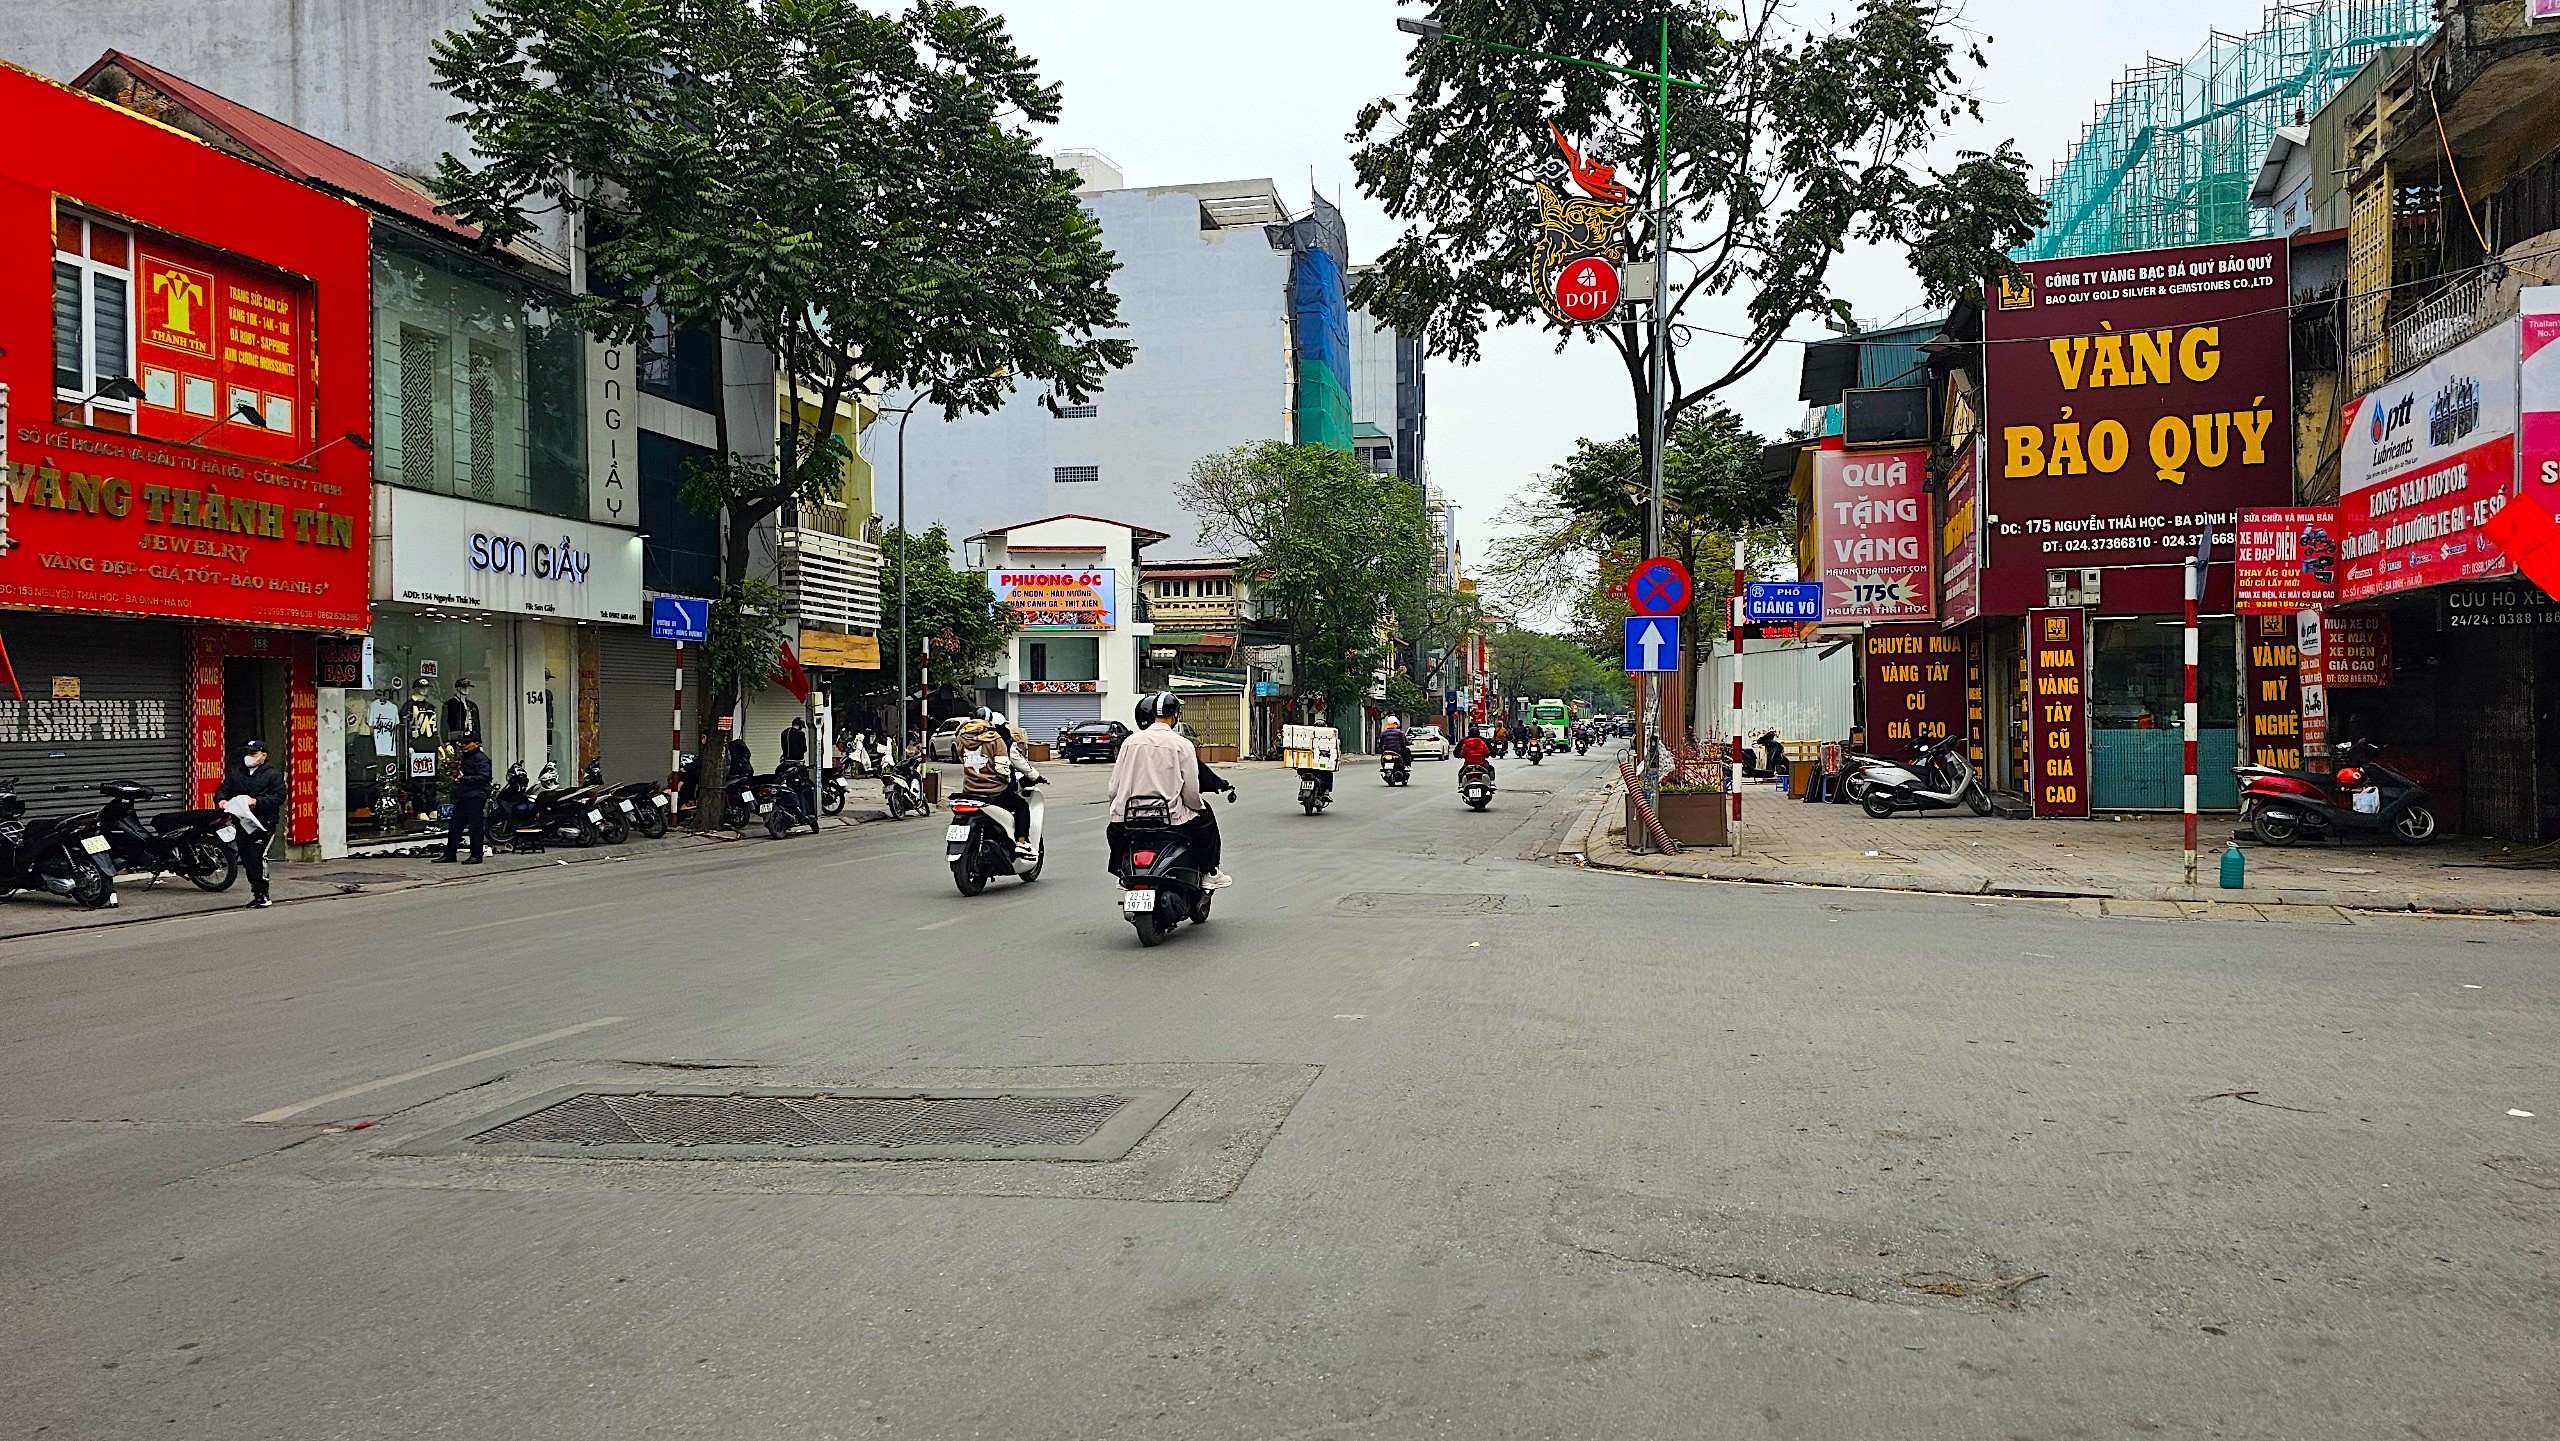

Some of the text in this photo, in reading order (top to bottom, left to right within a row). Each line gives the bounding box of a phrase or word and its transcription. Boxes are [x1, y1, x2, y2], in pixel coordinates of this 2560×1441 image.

[2045, 252, 2273, 288] CÔNG TY VÀNG BẠC ĐÁ QUÝ BẢO QUÝ
[229, 286, 276, 311] TRANG CAO
[1566, 290, 1608, 311] DOJI
[2045, 275, 2274, 305] BAO QUY GOLD SILVER & GEMSTONES CO.,LTD
[263, 316, 275, 331] 14K
[260, 335, 290, 355] SAPPHIRE
[2050, 320, 2221, 390] VÀNG
[2384, 390, 2414, 441] ptt
[2003, 405, 2129, 478] BẢO
[2149, 395, 2273, 485] QUÝ
[46, 431, 69, 449] KẾ
[253, 469, 290, 487] CÔNG
[292, 477, 307, 490] TY
[2372, 436, 2414, 467] Lubricants
[1842, 456, 1908, 488] QUÀ
[2369, 463, 2469, 518] LONG NAM MOTOR
[6, 456, 354, 549] VÀNG THÀNH TÍN
[1834, 495, 1918, 529] TẶNG
[2000, 511, 2226, 535] ĐC: 175 NGUYỄN THÁI HỌC BA ĐÌNH
[2243, 512, 2334, 523] SỬA CHỮA VÀ MUA BÁN
[2385, 517, 2404, 550] BẢO
[2404, 513, 2437, 545] DƯỠNG
[2437, 510, 2451, 537] XE
[2451, 505, 2467, 532] GA
[2473, 499, 2489, 527] XE
[138, 533, 250, 565] JEWELRY
[1833, 533, 1919, 565] VÀNG
[2042, 536, 2151, 552] ĐT: 024.37366810
[2239, 525, 2297, 568] XE MÁY ĐIỆN
[2239, 548, 2276, 564] XE ĐẠP
[38, 551, 222, 585] VÀNG ĐẸP TỐT
[2239, 569, 2300, 577] THAY QUY
[1001, 571, 1102, 587] PHƯƠNG ỐC
[402, 590, 433, 601] ADD: 154
[1777, 586, 1801, 596] PHỐ
[1853, 583, 1901, 602] 175C
[2239, 591, 2252, 599] MUA
[2252, 591, 2262, 599] XE
[2278, 591, 2287, 599] XE
[2322, 590, 2335, 599] CAO
[2523, 590, 2545, 605] XE
[1753, 596, 1815, 615] GIẢNG VÕ
[2324, 618, 2363, 630] MUA XE
[2450, 613, 2532, 627] 24/24: 0388
[253, 638, 268, 648] 158
[1868, 633, 1961, 655] CHUYÊN MUA
[2329, 633, 2345, 643] XE
[2347, 632, 2374, 643] MÁY
[2040, 649, 2075, 668] MUA
[2253, 642, 2297, 667] VÀNG
[2329, 645, 2375, 659] XE ĐIỆN
[323, 664, 356, 686] BẠC
[1881, 661, 1950, 683] VÀNG TÂY
[2328, 658, 2375, 671] GIÁ CAO
[2038, 673, 2079, 695] VÀNG
[2262, 675, 2288, 701] MỸ
[197, 698, 221, 716] TRANG
[292, 691, 315, 709] VÀNG
[526, 691, 544, 705] 154
[1906, 689, 1926, 711] CŨ
[292, 715, 316, 730] TRANG
[2044, 702, 2073, 724] TÂY
[1888, 717, 1946, 739] GIÁ CAO
[2254, 709, 2299, 740] NGHỆ
[2048, 728, 2070, 750] CŨ
[297, 759, 313, 774] 10K
[413, 762, 433, 773] SALE
[2046, 755, 2074, 777] GIÁ
[297, 781, 313, 796] 14K
[2045, 785, 2077, 803] CAO
[297, 802, 314, 818] 18K
